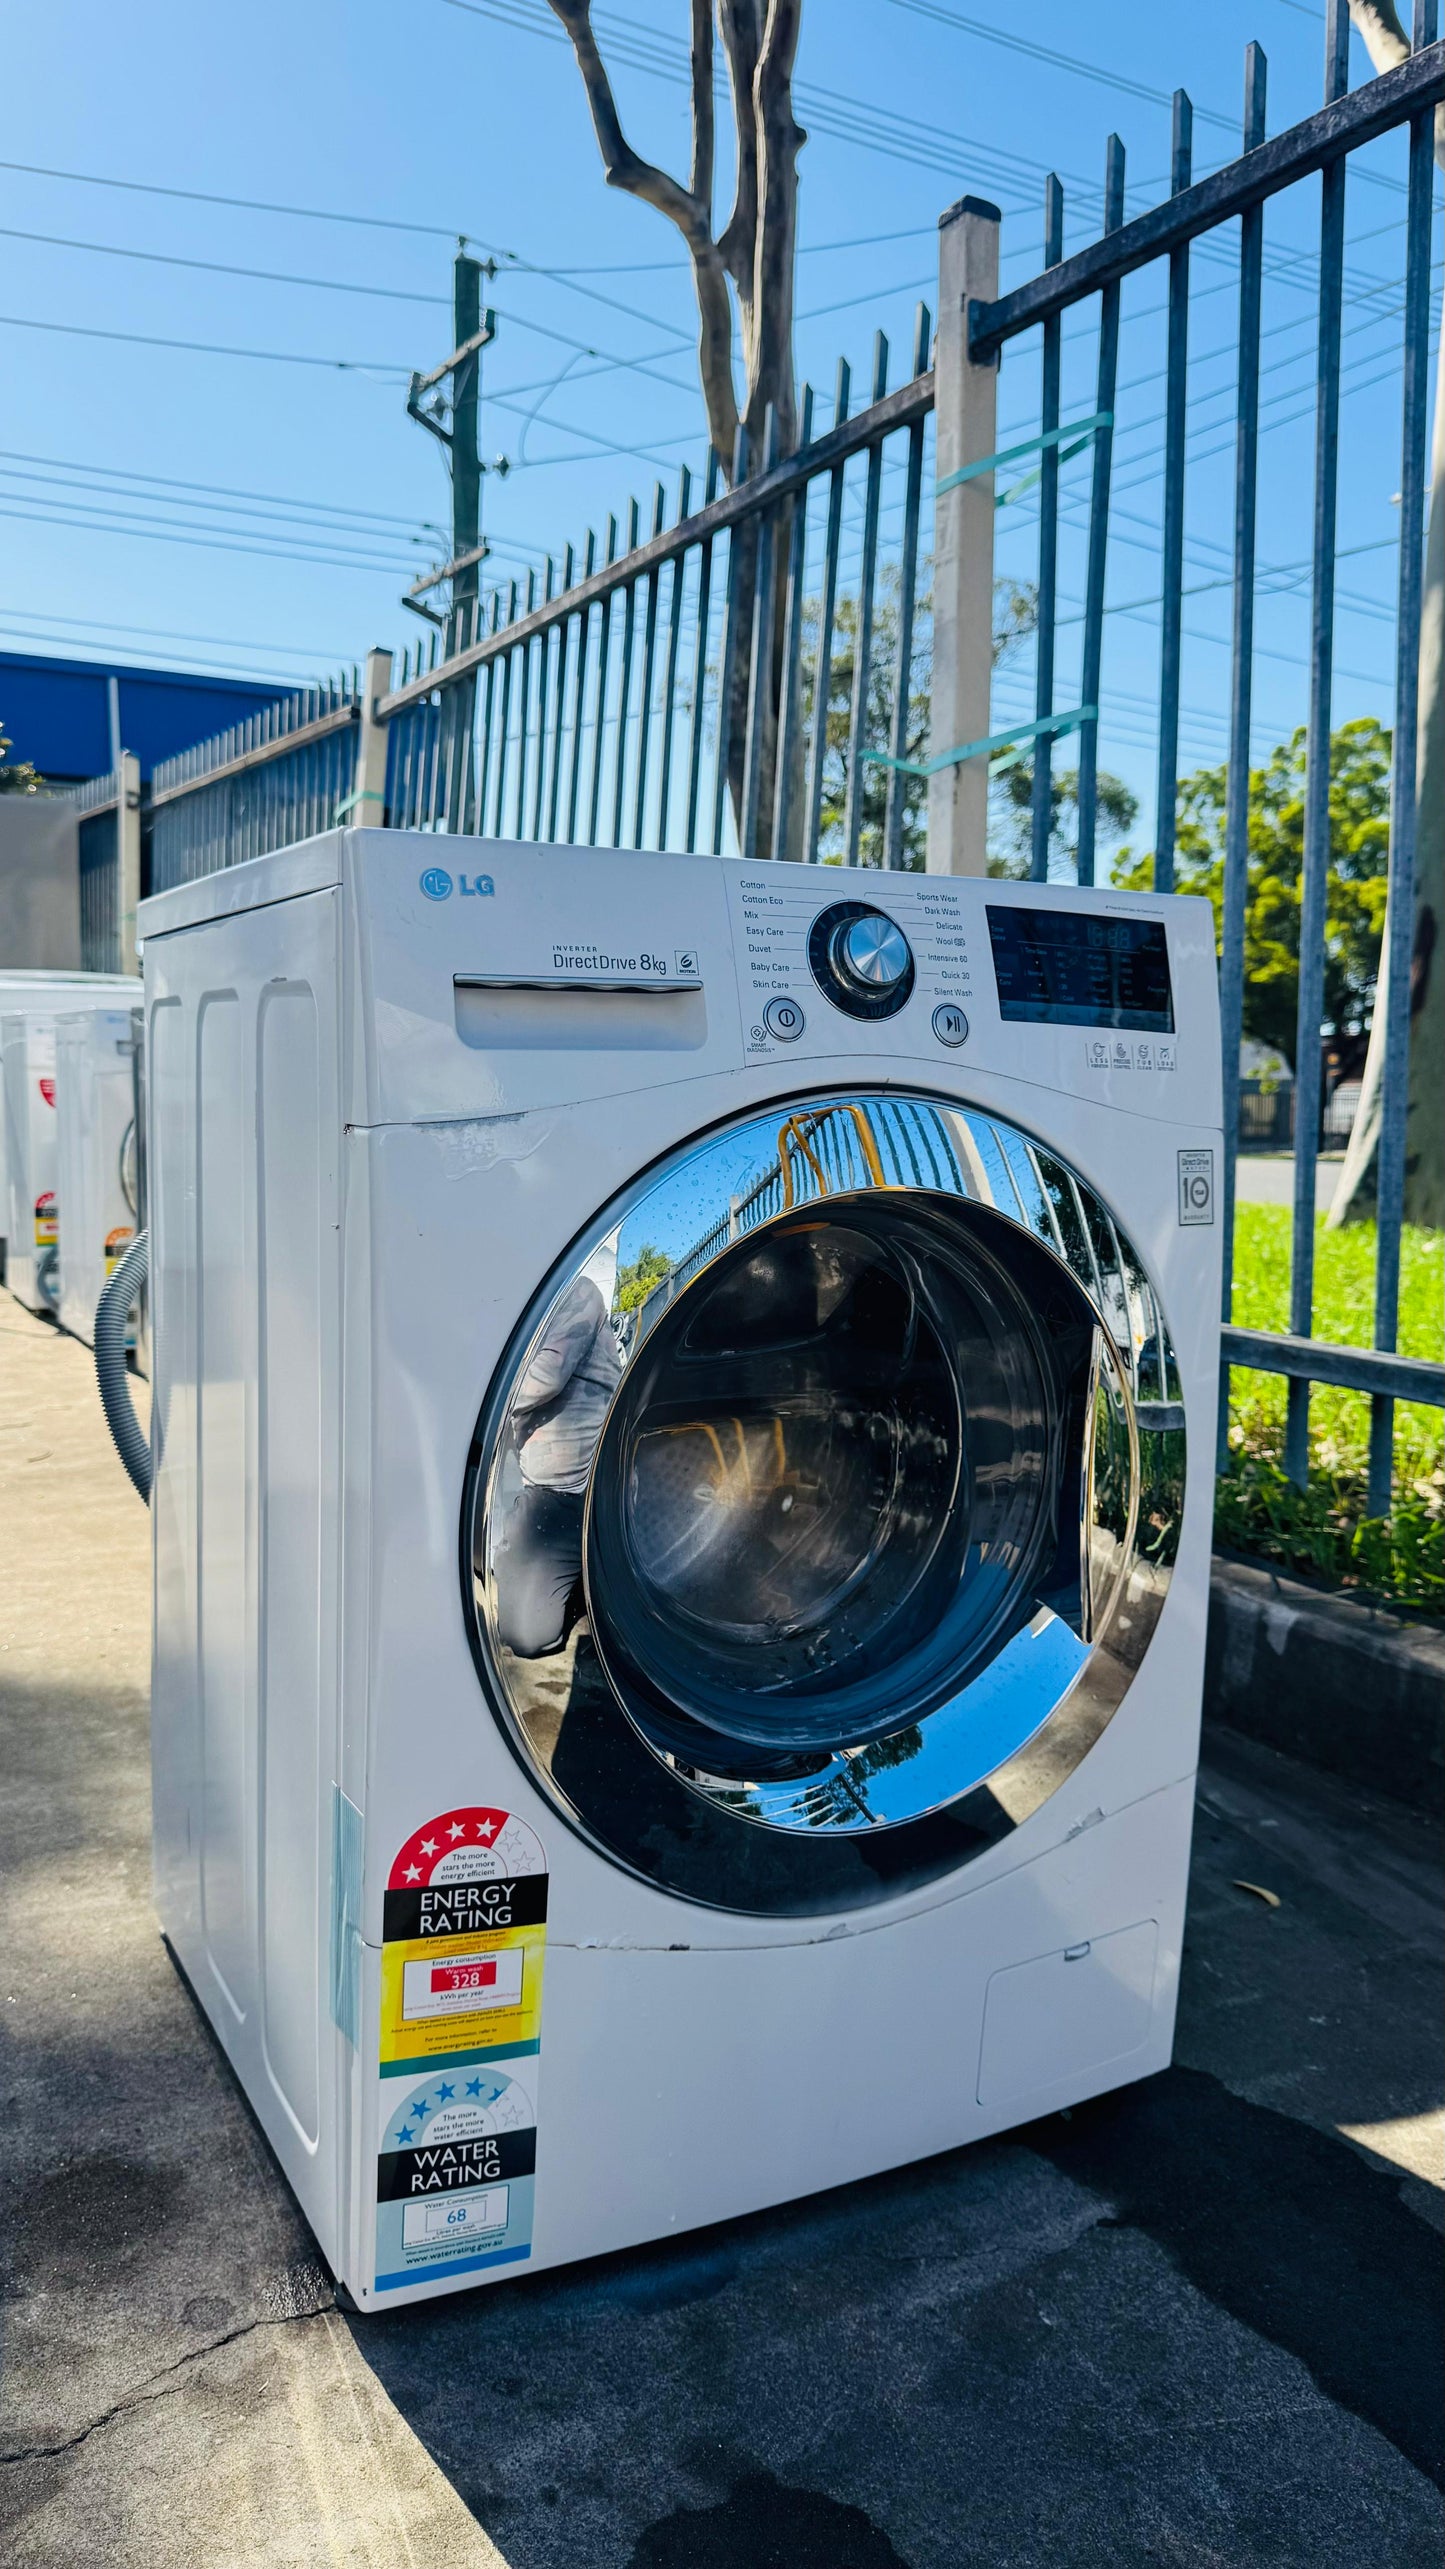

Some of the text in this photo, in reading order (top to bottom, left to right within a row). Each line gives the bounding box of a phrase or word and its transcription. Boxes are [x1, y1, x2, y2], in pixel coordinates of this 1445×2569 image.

[458, 874, 495, 897] LG
[740, 880, 765, 888] Cotton
[742, 895, 783, 904] Cotton Eco
[917, 893, 957, 902] Sports Wear
[744, 911, 758, 919] Mix
[941, 908, 960, 916] Wash
[936, 922, 963, 930] Delicate
[746, 927, 784, 936] Easy Care
[936, 937, 953, 945] Wool
[748, 944, 771, 952] Duvet
[928, 954, 958, 962] Intensive
[751, 962, 789, 972] Baby Care
[941, 971, 960, 979] Quick
[753, 980, 789, 989] Skin Care
[934, 988, 972, 997] Silent Wash
[1183, 1176, 1209, 1208] 10
[421, 1883, 516, 1912] ENERGY
[420, 1906, 512, 1934] RATING
[456, 1954, 496, 1963] consumption
[452, 1972, 479, 1988] 328
[456, 2128, 483, 2136] efficient
[414, 2140, 499, 2169] WATER
[411, 2160, 500, 2192] RATING
[425, 2194, 488, 2209] Water Consumption
[447, 2208, 466, 2224] 68
[406, 2240, 502, 2264] www.waterrating.gov.au
